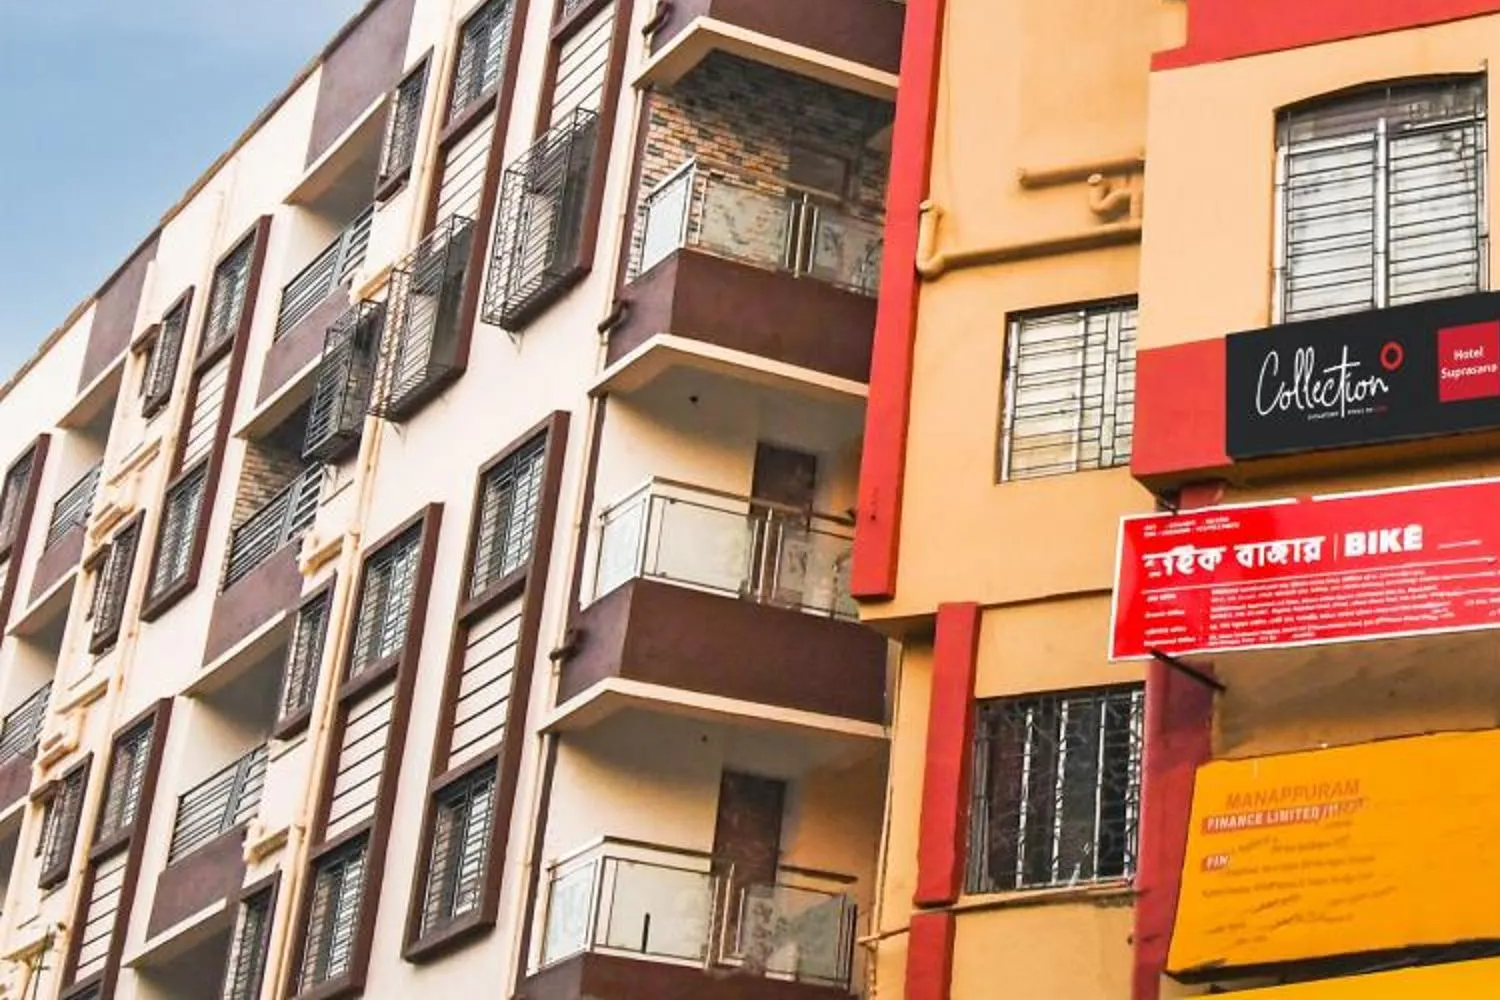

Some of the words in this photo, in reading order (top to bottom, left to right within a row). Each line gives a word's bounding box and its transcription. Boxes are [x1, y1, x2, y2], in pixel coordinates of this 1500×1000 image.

[1453, 345, 1484, 360] Hotel
[1255, 345, 1389, 417] Collection
[1344, 523, 1423, 557] BIKE
[1207, 810, 1263, 831] FINANCE
